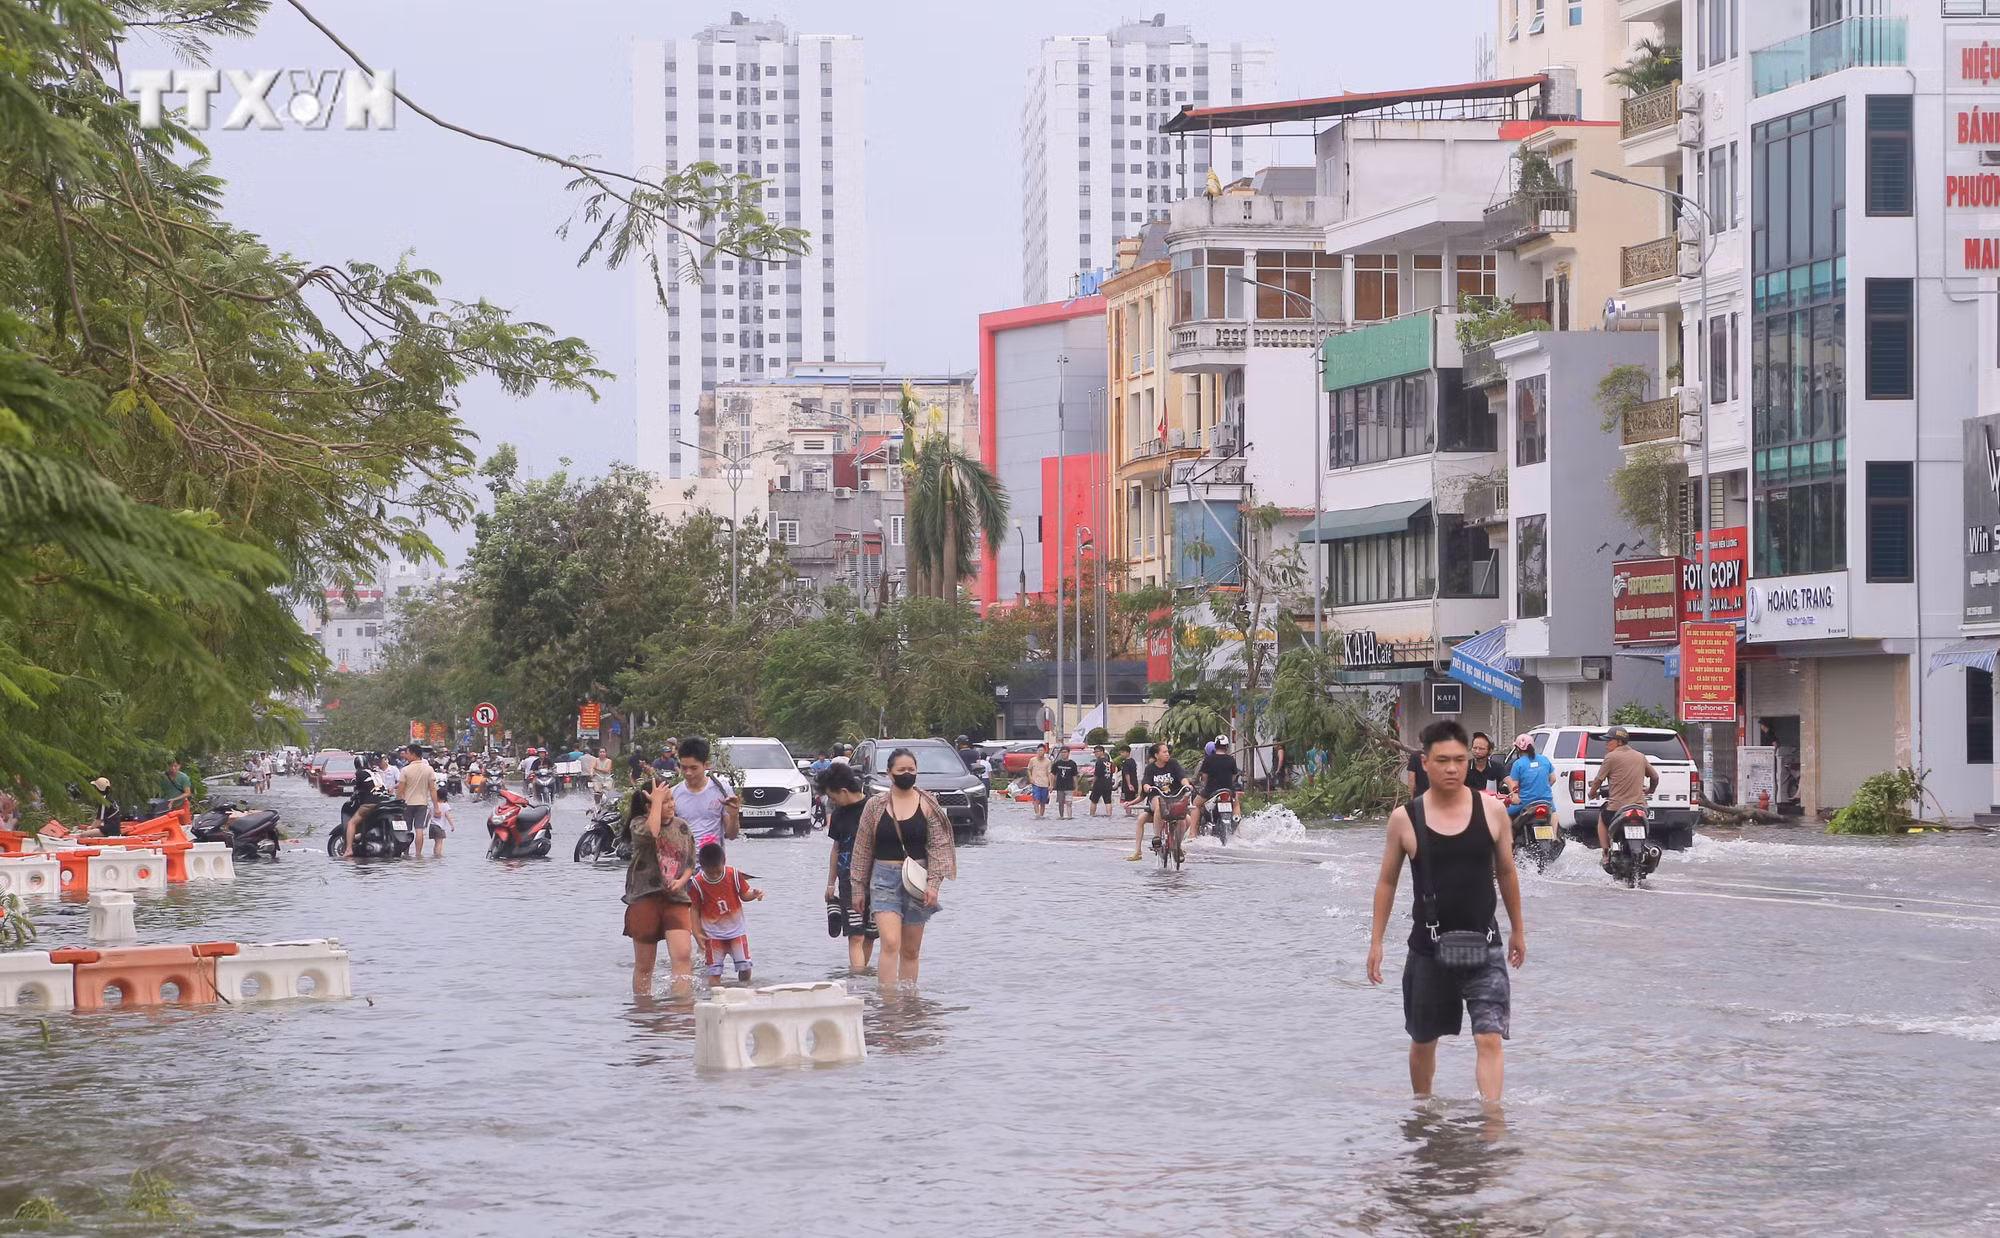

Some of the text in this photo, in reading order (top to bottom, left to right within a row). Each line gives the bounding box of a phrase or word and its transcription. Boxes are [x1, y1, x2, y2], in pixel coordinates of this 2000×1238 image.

[1969, 526, 1989, 553] Win
[1767, 585, 1832, 611] HOÀNG TRANG
[1344, 631, 1392, 666] KAFA Café
